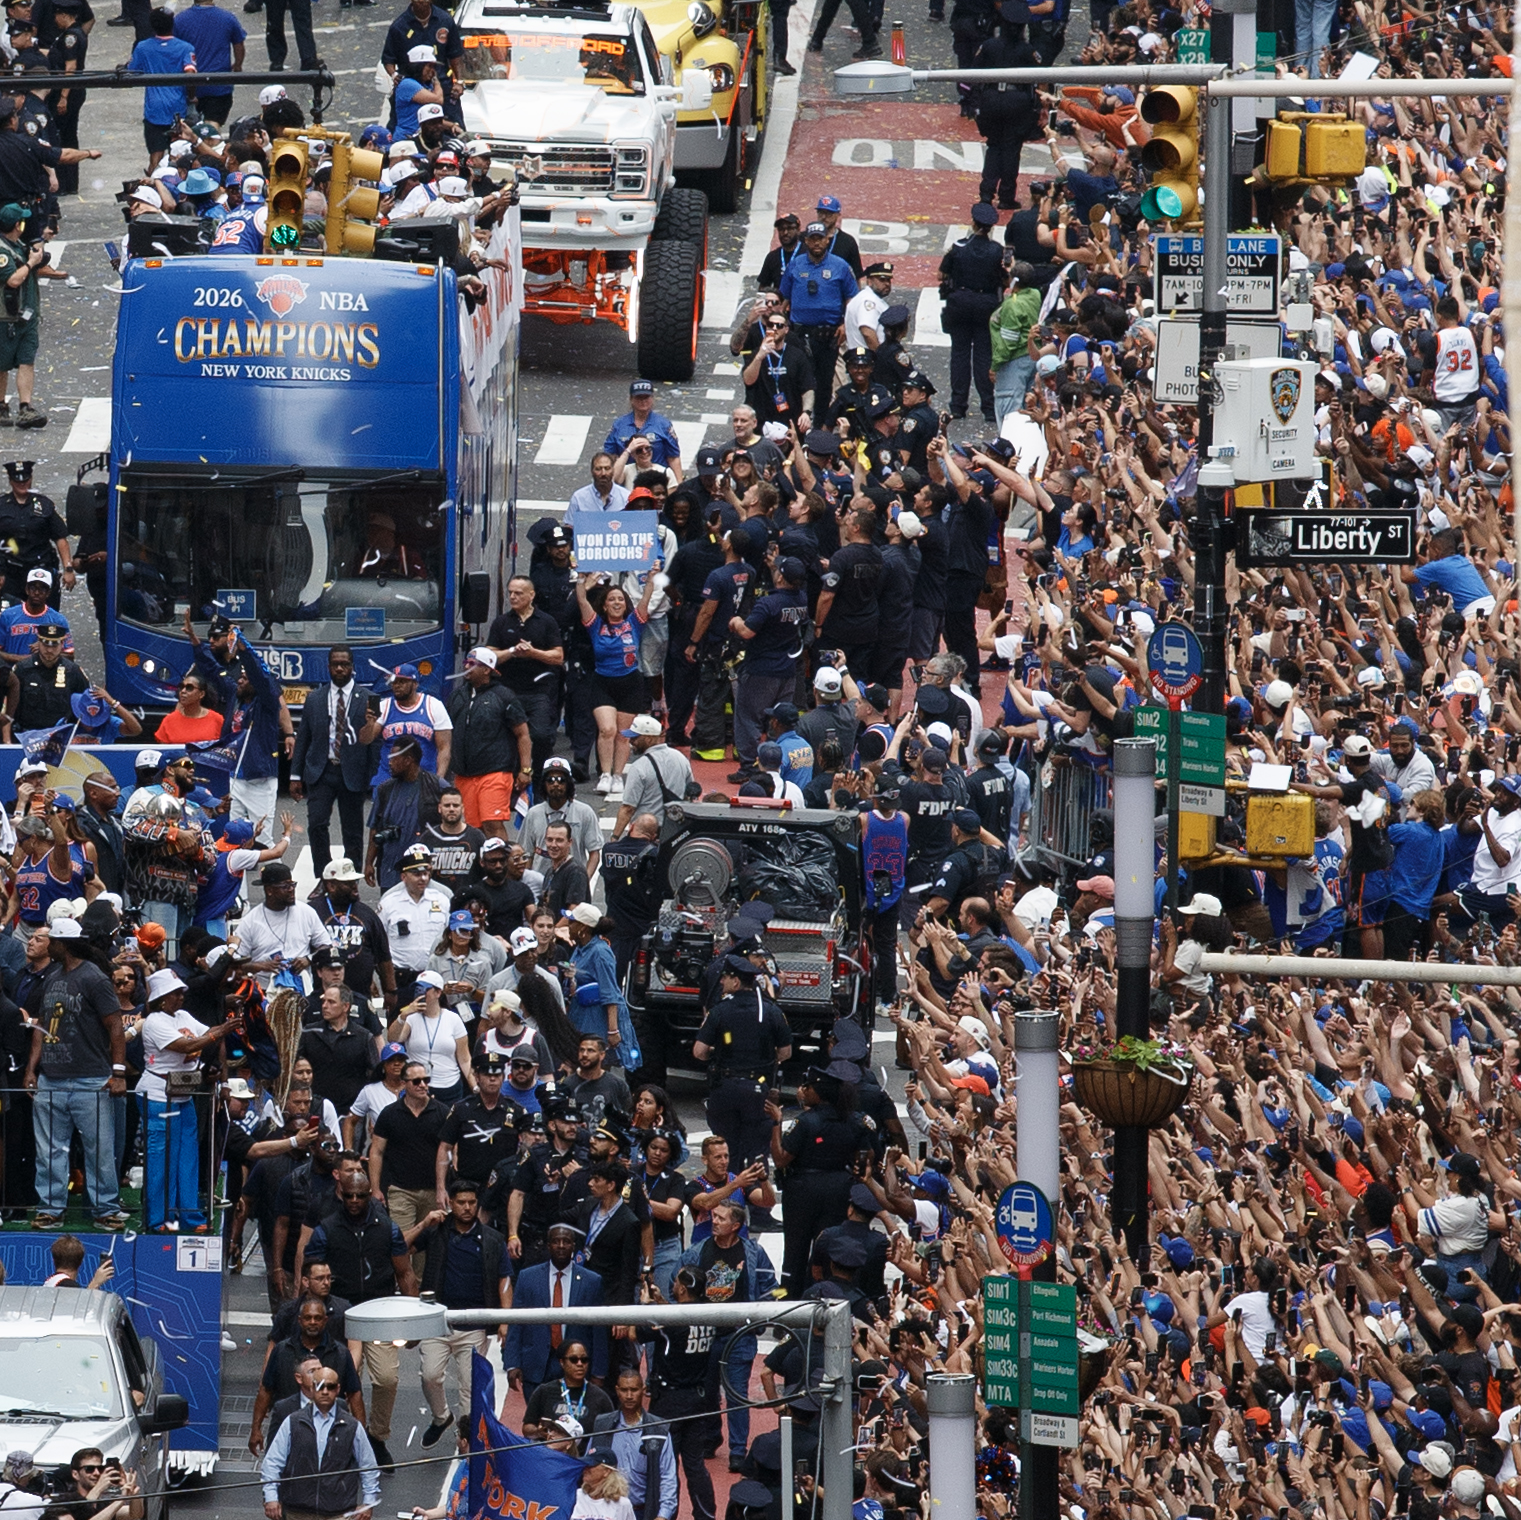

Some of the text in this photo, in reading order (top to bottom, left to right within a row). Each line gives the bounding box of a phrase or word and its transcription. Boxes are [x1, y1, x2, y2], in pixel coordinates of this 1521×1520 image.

[1227, 240, 1267, 253] LANE
[1226, 255, 1267, 268] ONLY
[193, 287, 243, 308] 2026
[319, 291, 369, 312] NBA
[174, 316, 381, 369] CHAMPIONS
[1445, 349, 1473, 376] 32
[200, 364, 351, 386] NEW YORK KNICKS
[1271, 428, 1297, 440] SECURITY
[1272, 458, 1296, 472] CAMERA
[1329, 517, 1356, 526] 77-101
[576, 532, 654, 548] WON FOR THE
[1297, 523, 1403, 556] Liberty ST
[578, 546, 643, 561] BOROUGHS
[227, 594, 245, 604] BUS
[1152, 674, 1199, 696] NO STANDING
[739, 823, 779, 834] ATV 168
[19, 886, 41, 911] 32
[188, 1250, 197, 1267] 1
[1001, 1241, 1050, 1268] NO STANDING
[986, 1282, 1010, 1299] SIM1
[1032, 1310, 1071, 1323] Port Richmond
[986, 1334, 1011, 1350] SIM4
[1033, 1362, 1076, 1376] Mariners Harbor
[987, 1384, 1012, 1401] MTA
[1033, 1387, 1046, 1400] Drop
[1056, 1390, 1068, 1402] Only
[1033, 1415, 1059, 1429] Broadway
[1033, 1427, 1058, 1439] Cortlandt
